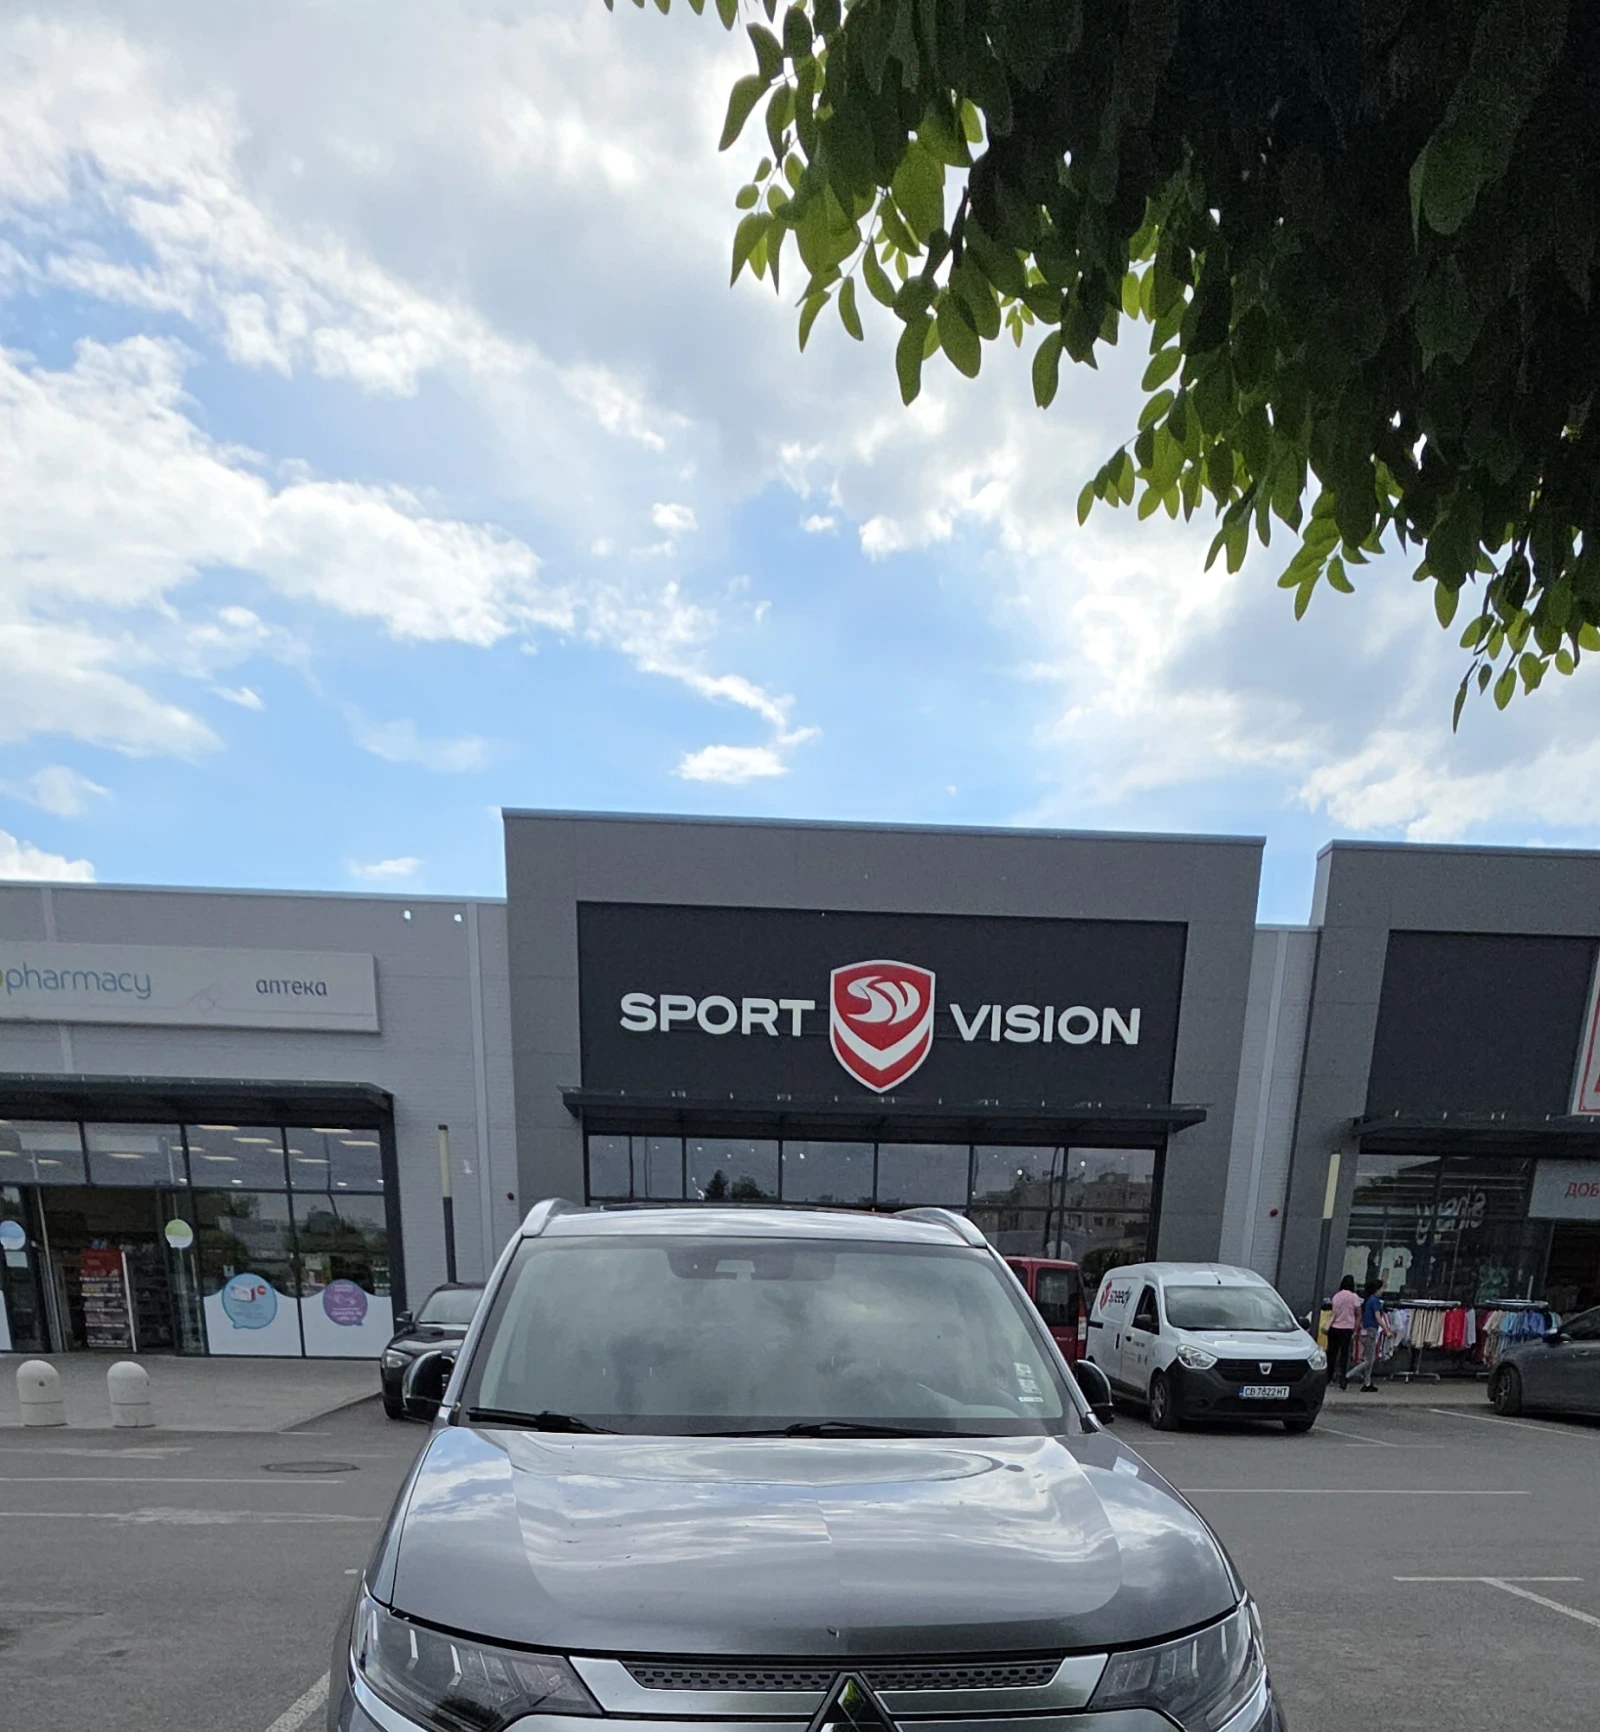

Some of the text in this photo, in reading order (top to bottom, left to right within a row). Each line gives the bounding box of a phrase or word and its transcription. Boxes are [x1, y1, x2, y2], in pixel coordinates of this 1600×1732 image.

[0, 961, 152, 1000] pharmacy
[256, 977, 328, 997] аптека
[619, 992, 816, 1038] SPORT
[949, 1003, 1141, 1046] VISION
